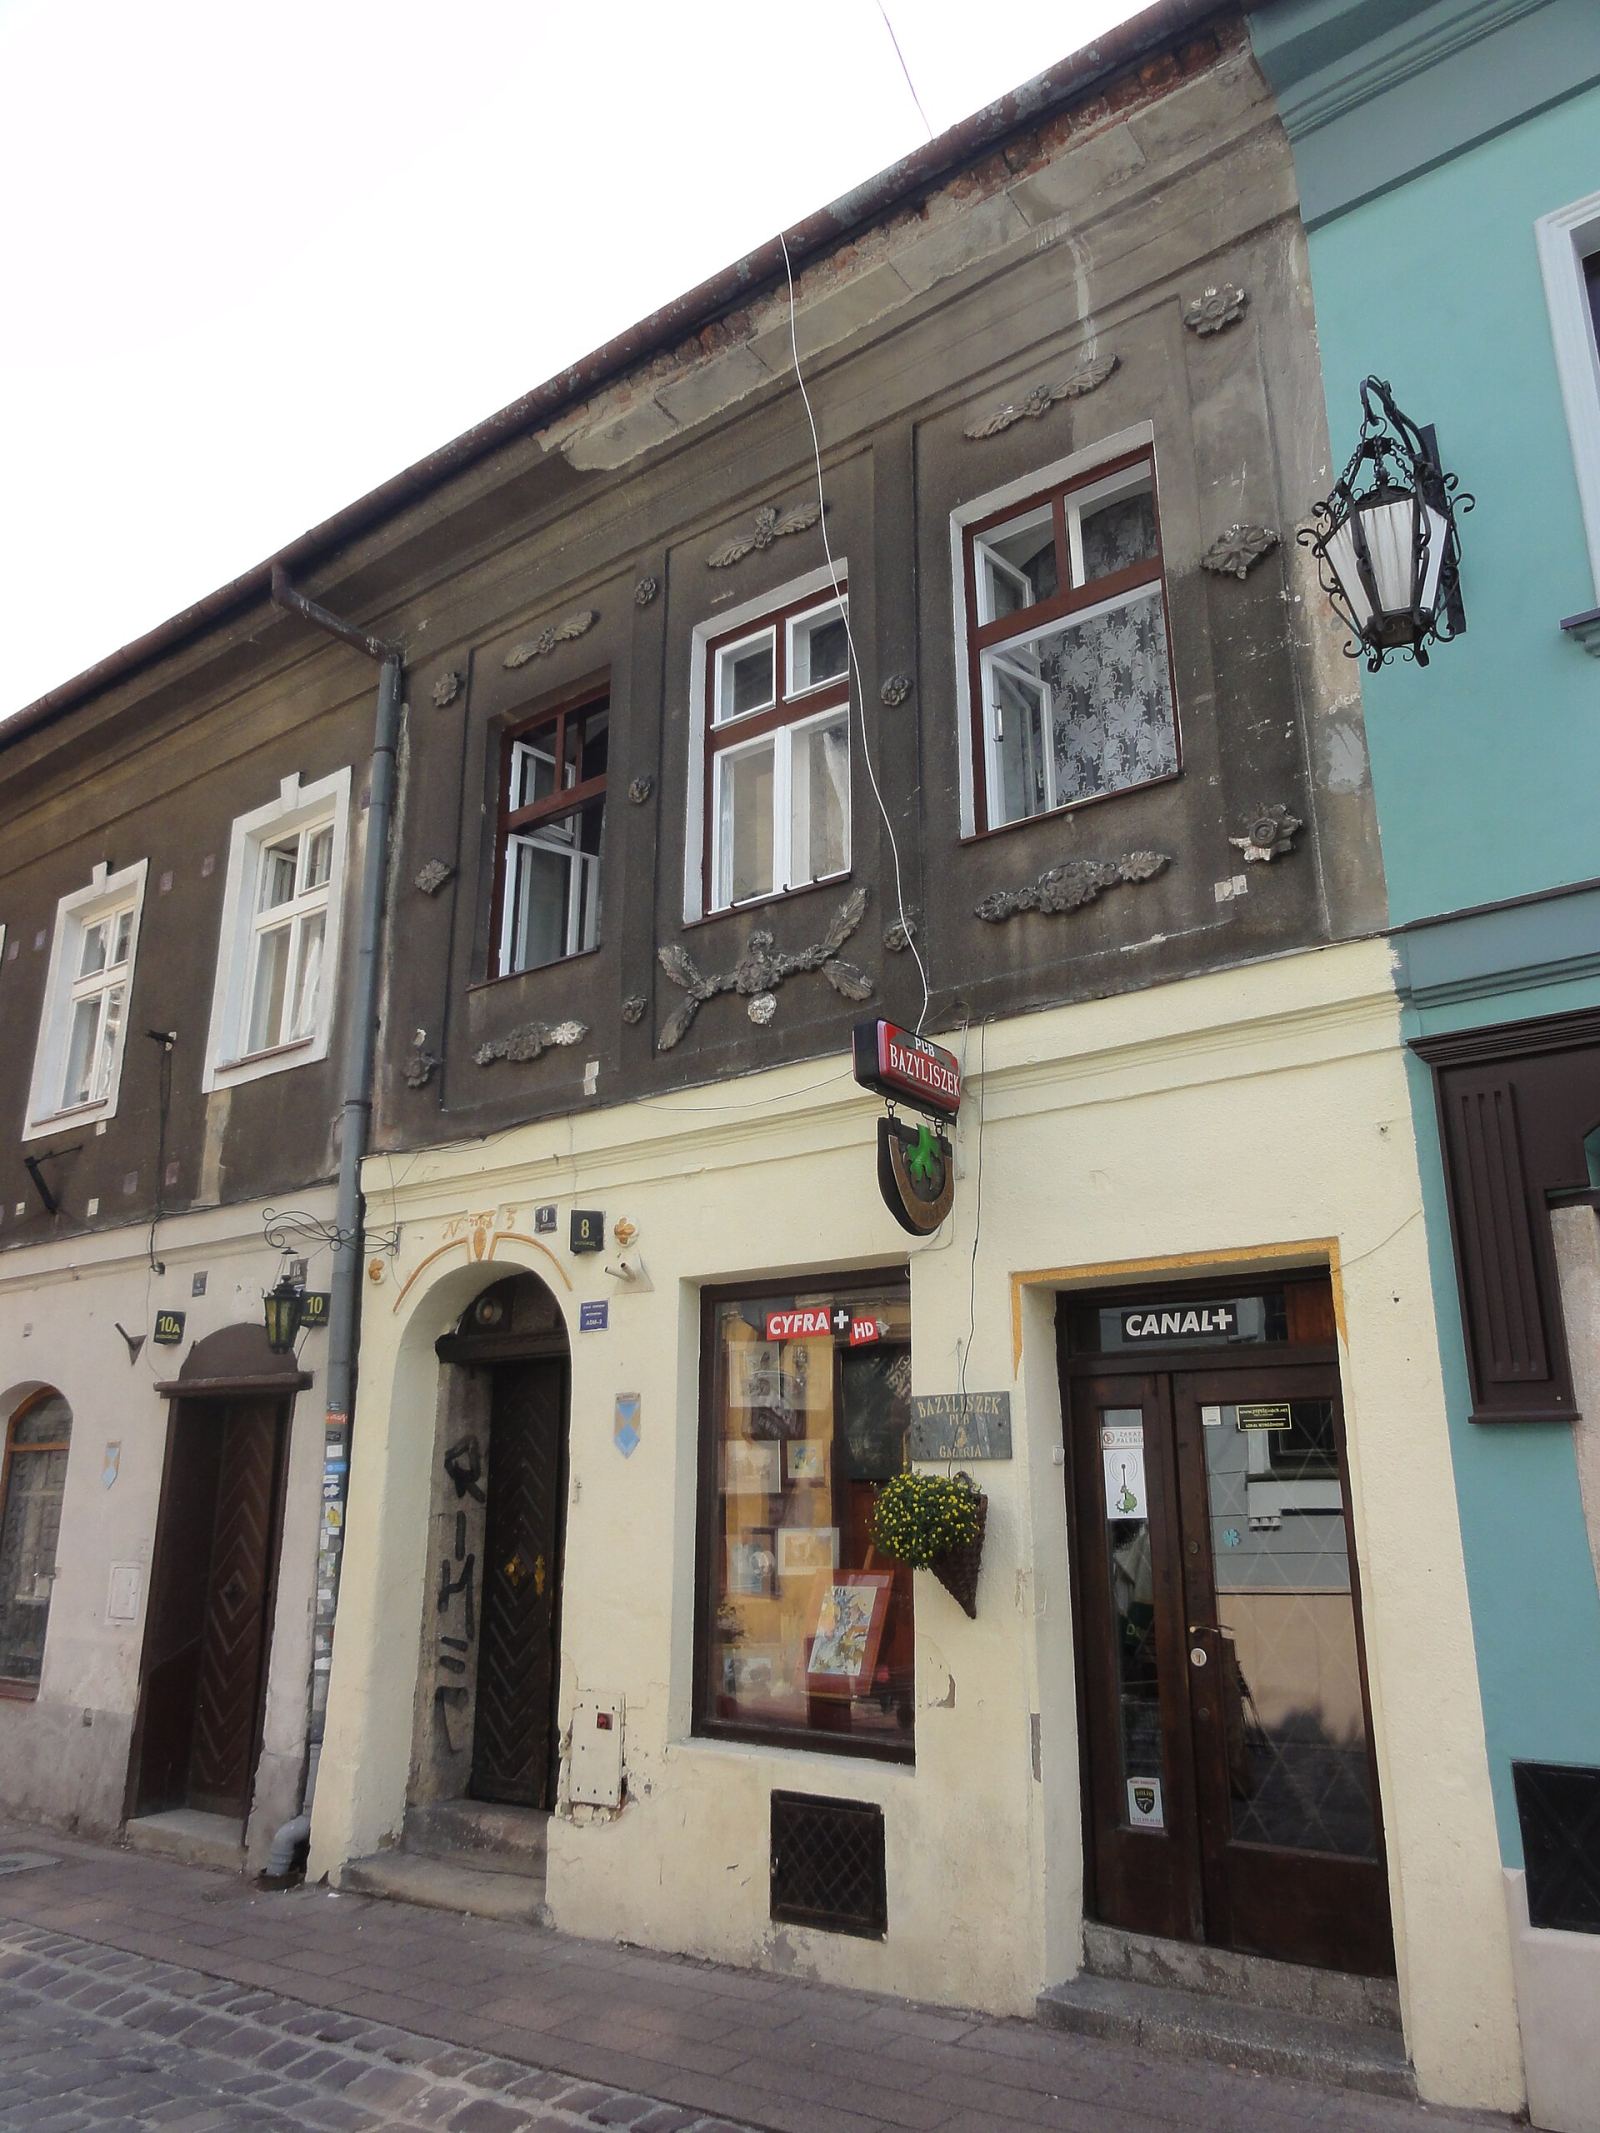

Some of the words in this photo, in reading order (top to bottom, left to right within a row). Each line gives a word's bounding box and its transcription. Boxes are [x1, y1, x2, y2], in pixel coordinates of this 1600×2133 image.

[914, 1036, 936, 1058] PUB
[889, 1043, 960, 1097] BAZYLISZEK
[580, 1218, 590, 1239] 8
[306, 1296, 323, 1314] 10
[158, 1316, 181, 1334] 10A
[853, 1321, 874, 1339] HD
[1125, 1308, 1233, 1336] CANAL+
[917, 1395, 1001, 1418] BAZYLISZEK
